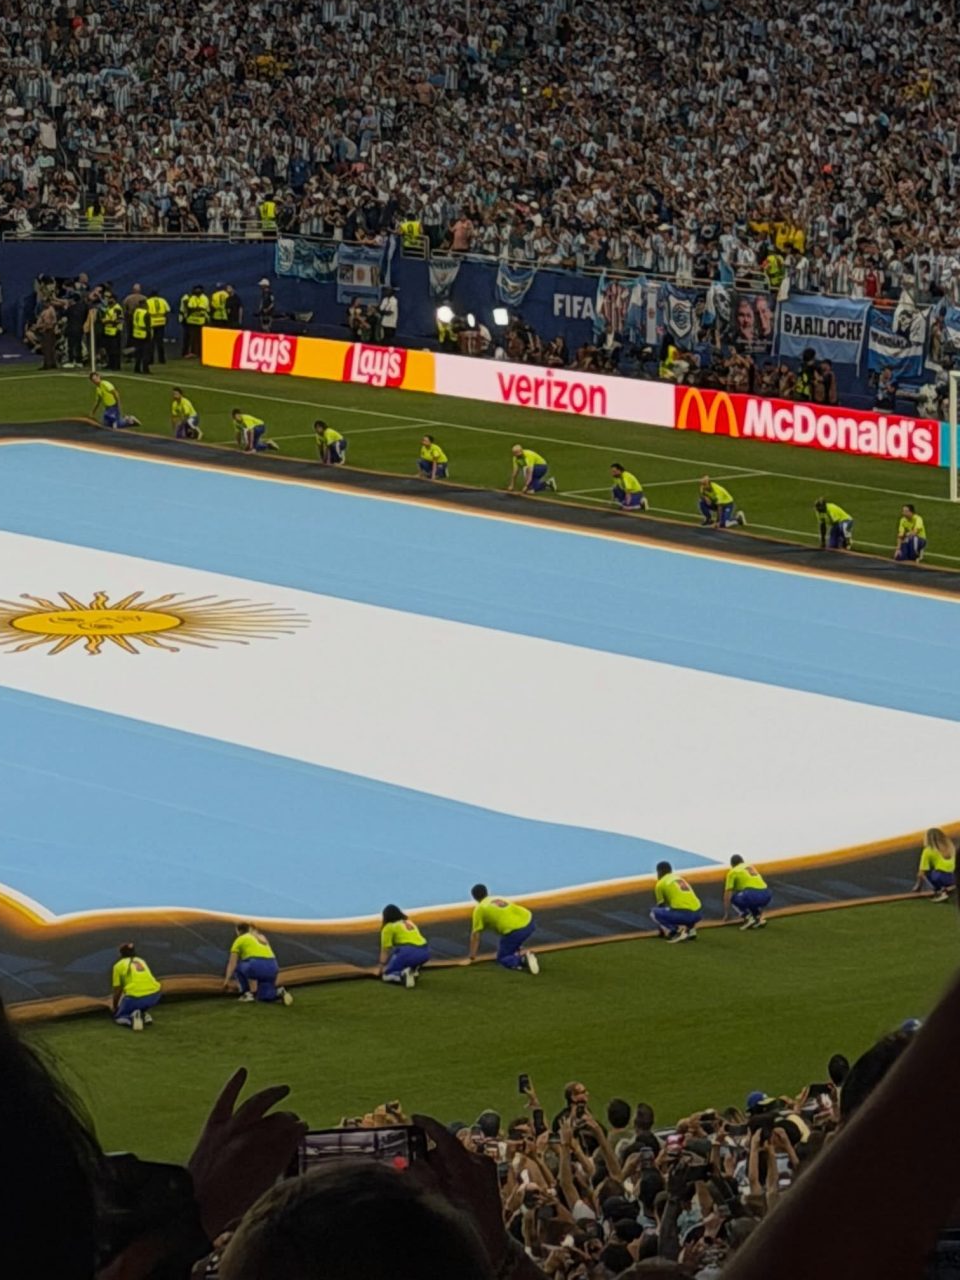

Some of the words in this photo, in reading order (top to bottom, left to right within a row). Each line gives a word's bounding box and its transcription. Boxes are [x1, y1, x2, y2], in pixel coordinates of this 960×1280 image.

[553, 293, 596, 320] FIFA
[497, 369, 607, 415] verizon
[742, 397, 934, 463] McDonald's
